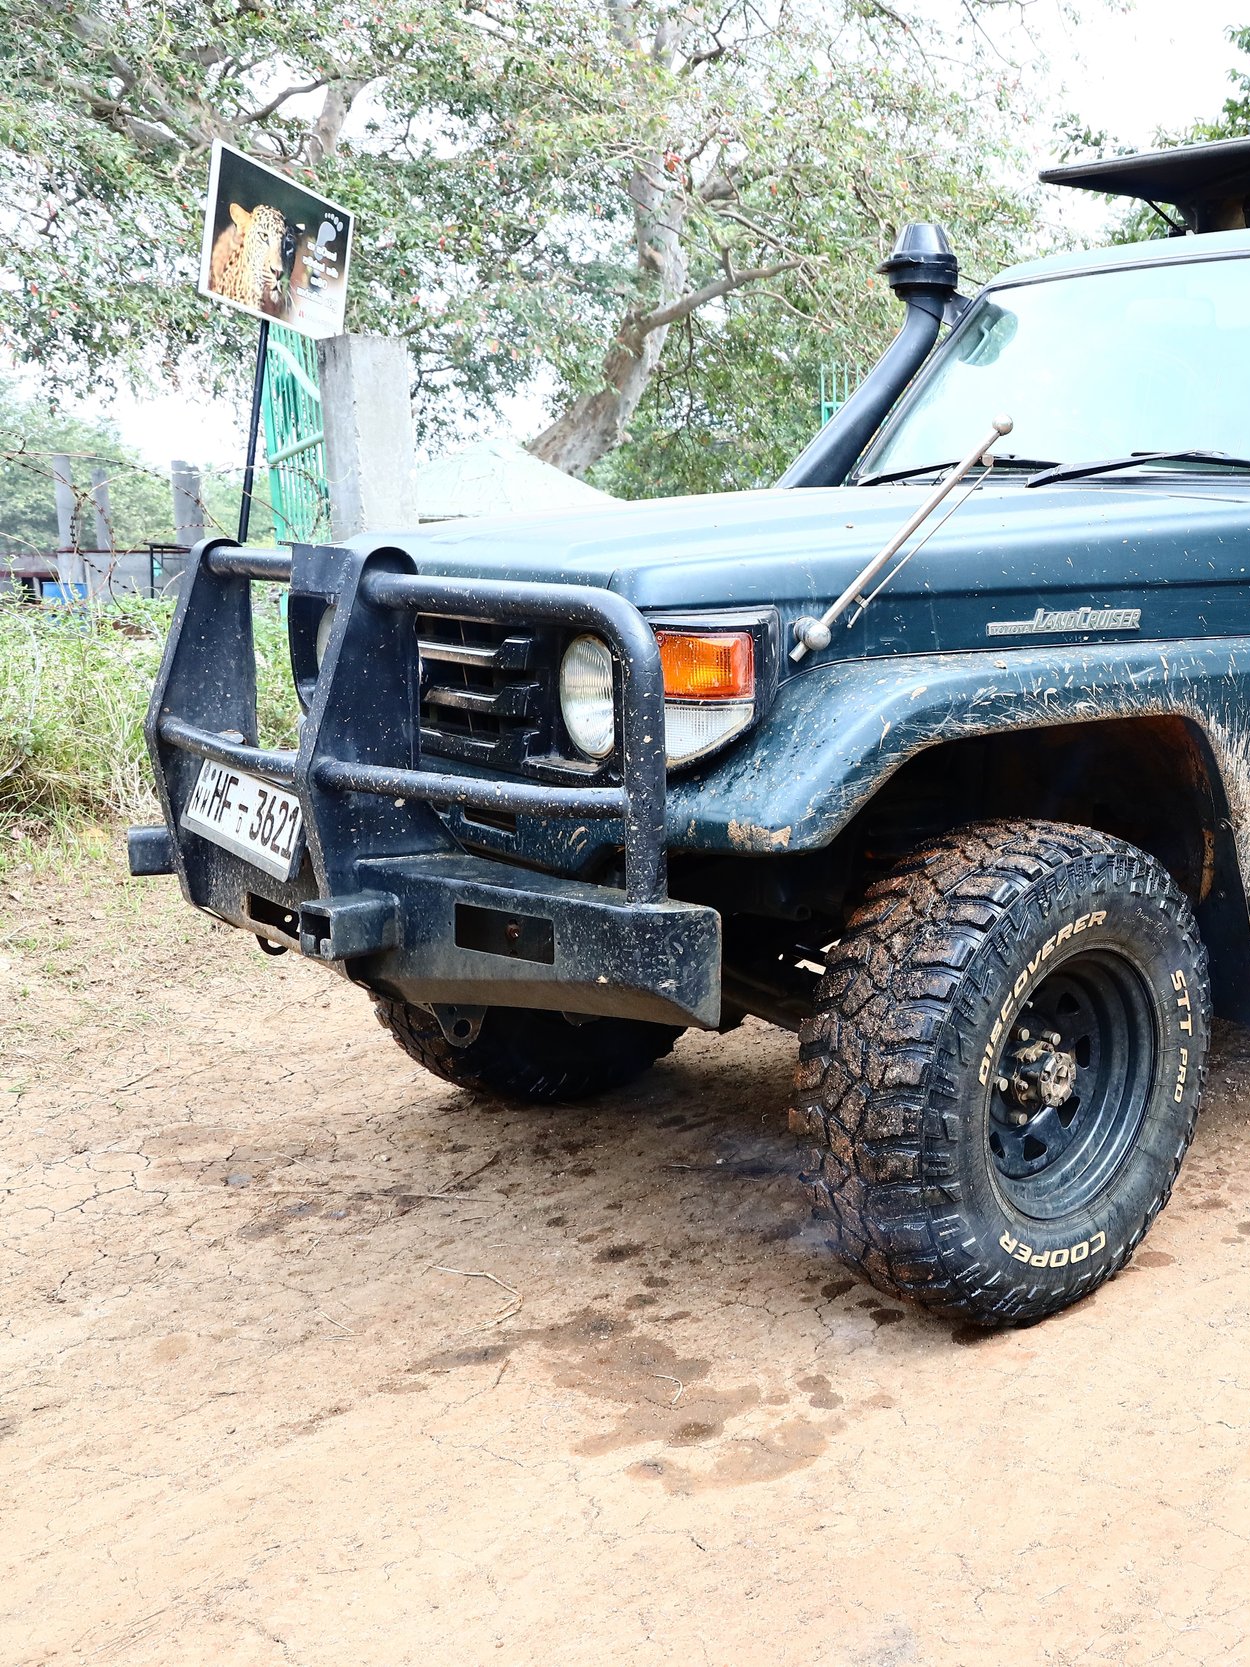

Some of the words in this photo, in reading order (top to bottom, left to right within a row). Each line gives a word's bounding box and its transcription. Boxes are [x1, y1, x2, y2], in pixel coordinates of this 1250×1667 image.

[991, 624, 1032, 635] TOYOTA
[978, 910, 1107, 1087] DISCOVERER
[1170, 968, 1193, 1037] STT
[1173, 1047, 1188, 1104] PRO
[999, 1229, 1106, 1269] COOPER
